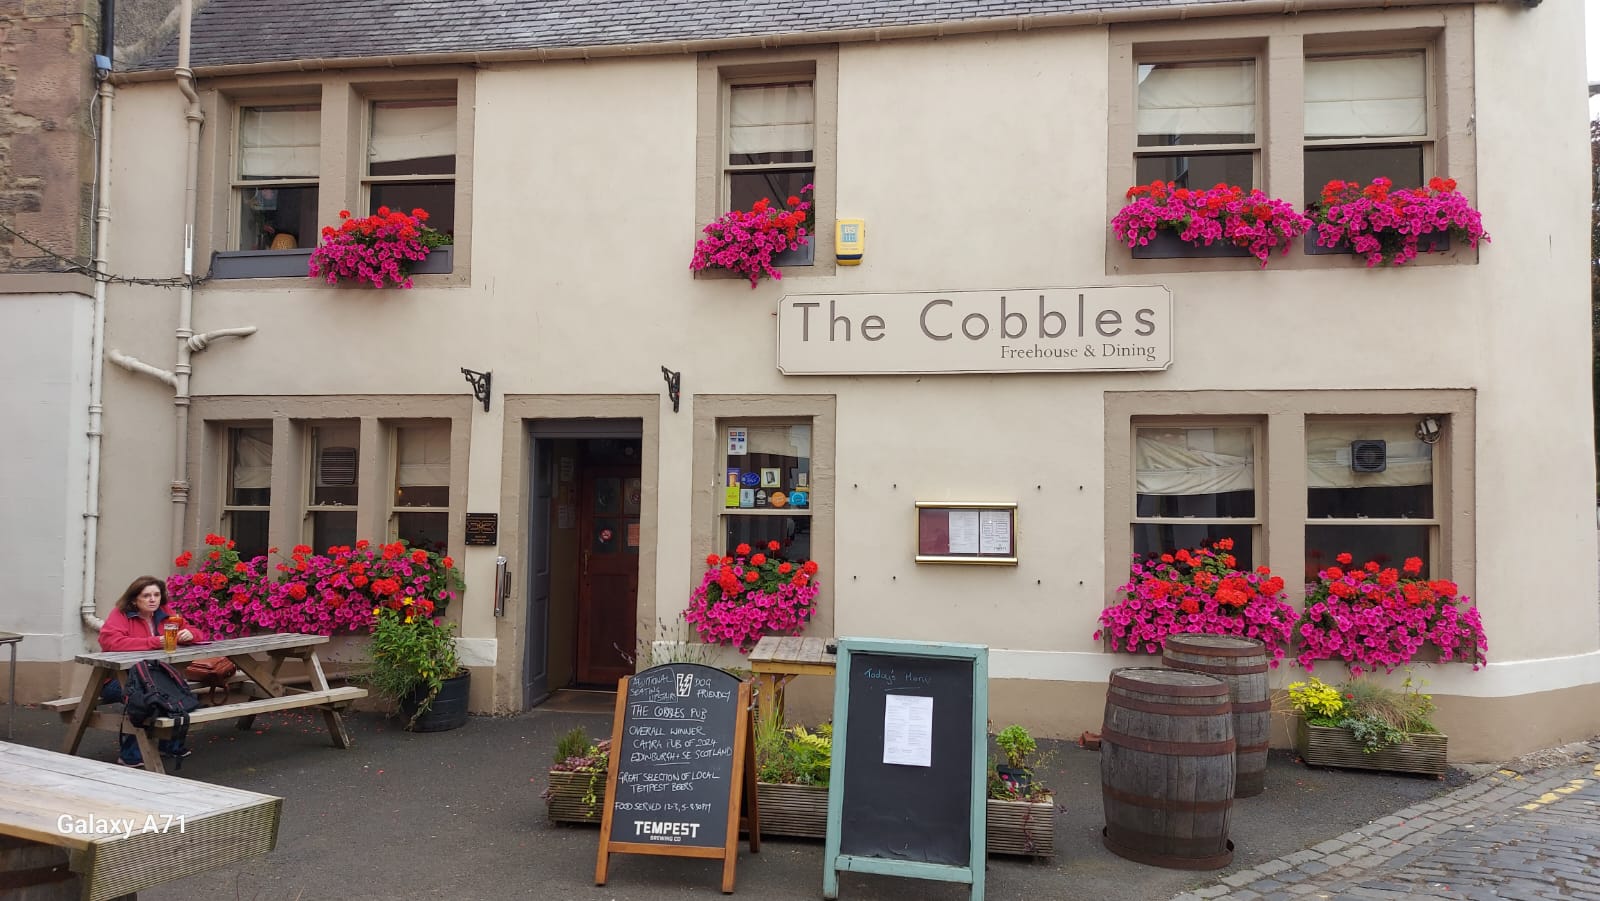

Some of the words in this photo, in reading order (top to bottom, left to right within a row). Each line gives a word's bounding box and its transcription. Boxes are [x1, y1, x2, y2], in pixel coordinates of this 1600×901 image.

[793, 299, 886, 342] The
[920, 293, 1156, 342] Cobbles
[1000, 344, 1078, 359] Freehouse
[1083, 344, 1096, 358] &
[1102, 343, 1156, 362] Dining
[864, 668, 896, 685] Today's
[694, 678, 712, 689] DOG
[631, 704, 649, 717] THE
[654, 705, 685, 718] COBBLES
[690, 707, 708, 720] PUB
[629, 725, 666, 736] OVERALL
[670, 725, 707, 736] WINNER
[633, 739, 662, 750] CAMRA
[666, 738, 682, 748] PUB
[684, 738, 695, 748] OF
[695, 738, 718, 747] 2024
[682, 751, 692, 760] SE
[695, 746, 733, 760] SCOTLAND
[618, 772, 642, 784] GREAT
[643, 772, 680, 782] SELECTION
[680, 772, 691, 781] OF
[691, 771, 720, 781] LOCAL
[630, 783, 670, 793] TEMPEST
[671, 782, 694, 792] BEERS
[614, 801, 633, 811] FOOD
[634, 820, 701, 838] TEMPEST
